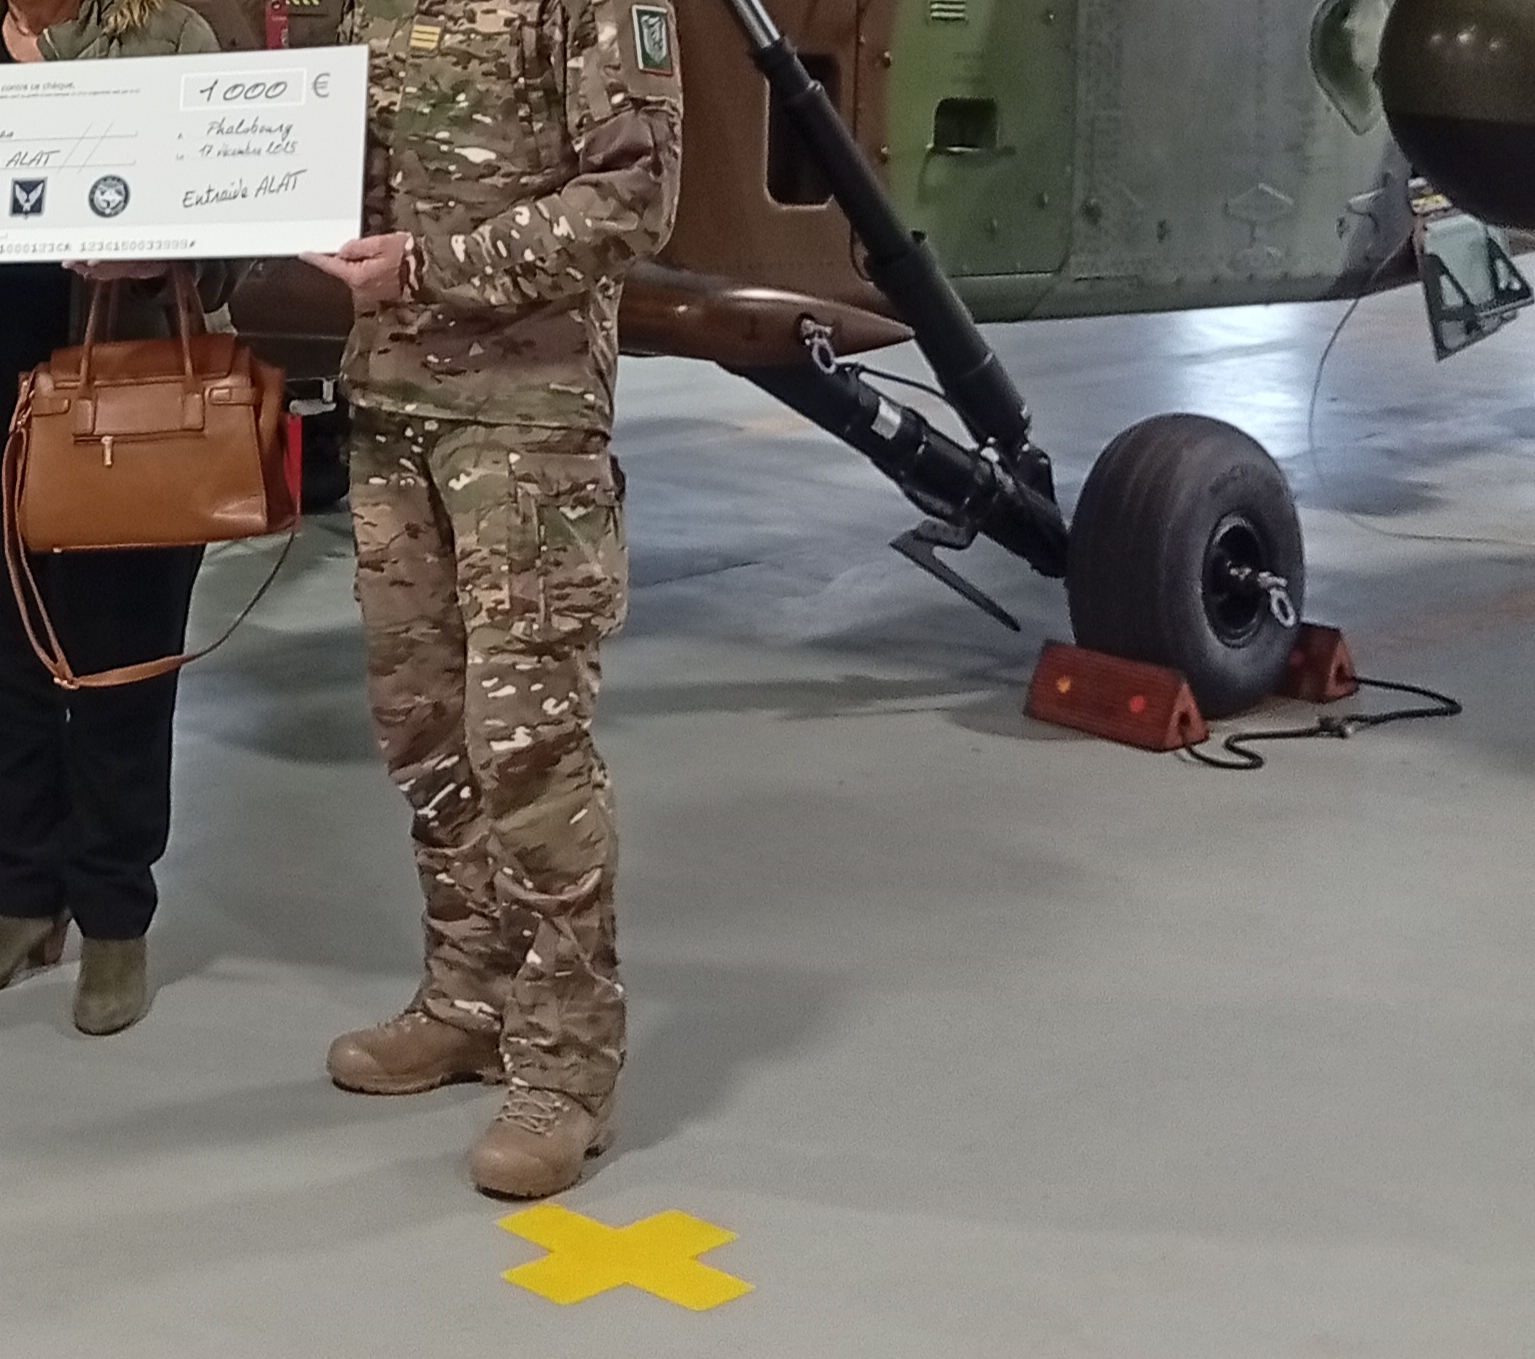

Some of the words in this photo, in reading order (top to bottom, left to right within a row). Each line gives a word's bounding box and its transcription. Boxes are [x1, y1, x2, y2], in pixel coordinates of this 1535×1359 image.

[312, 73, 330, 98] €
[207, 116, 293, 141] Phalsbourg
[6, 150, 61, 169] ALAT
[183, 178, 248, 208] Entraide
[255, 169, 308, 198] ALAT
